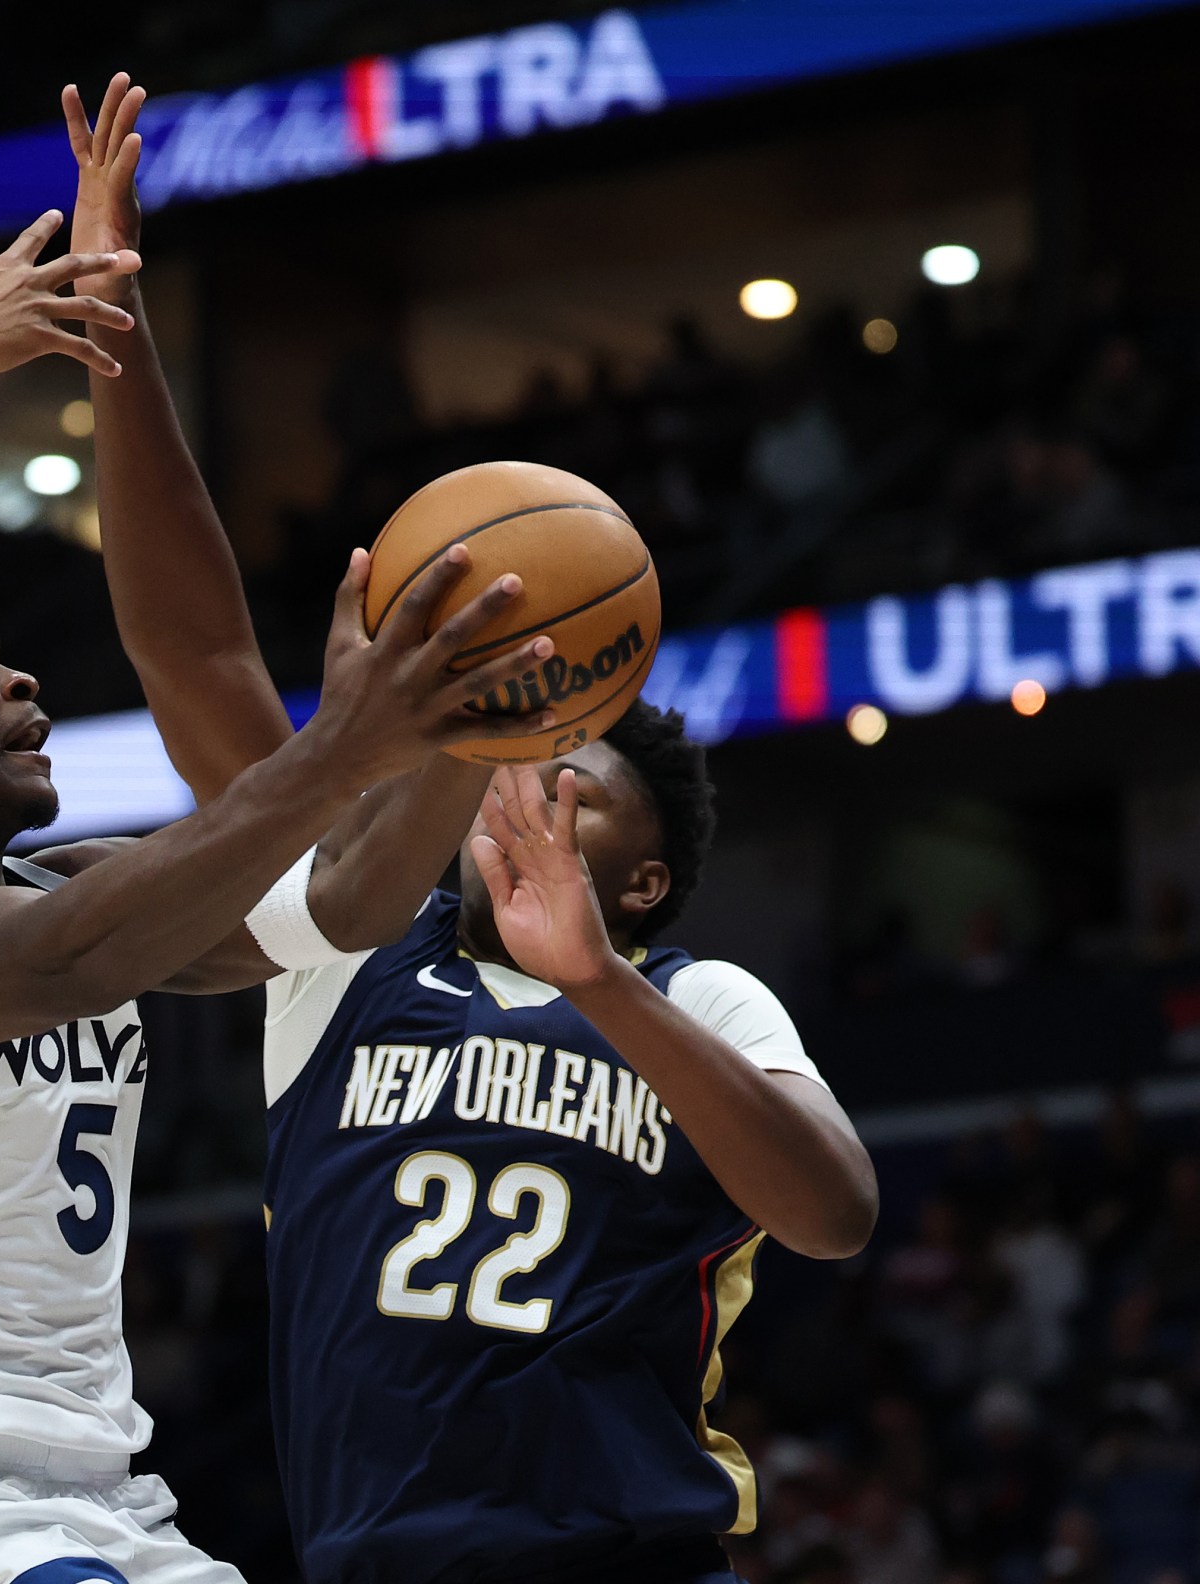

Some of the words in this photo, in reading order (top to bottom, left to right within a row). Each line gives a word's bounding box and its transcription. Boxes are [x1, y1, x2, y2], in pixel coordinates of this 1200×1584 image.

[56, 1103, 118, 1255] 5
[338, 1044, 462, 1129] NEW
[454, 1035, 672, 1175] ORLEANS
[376, 1150, 571, 1334] 22
